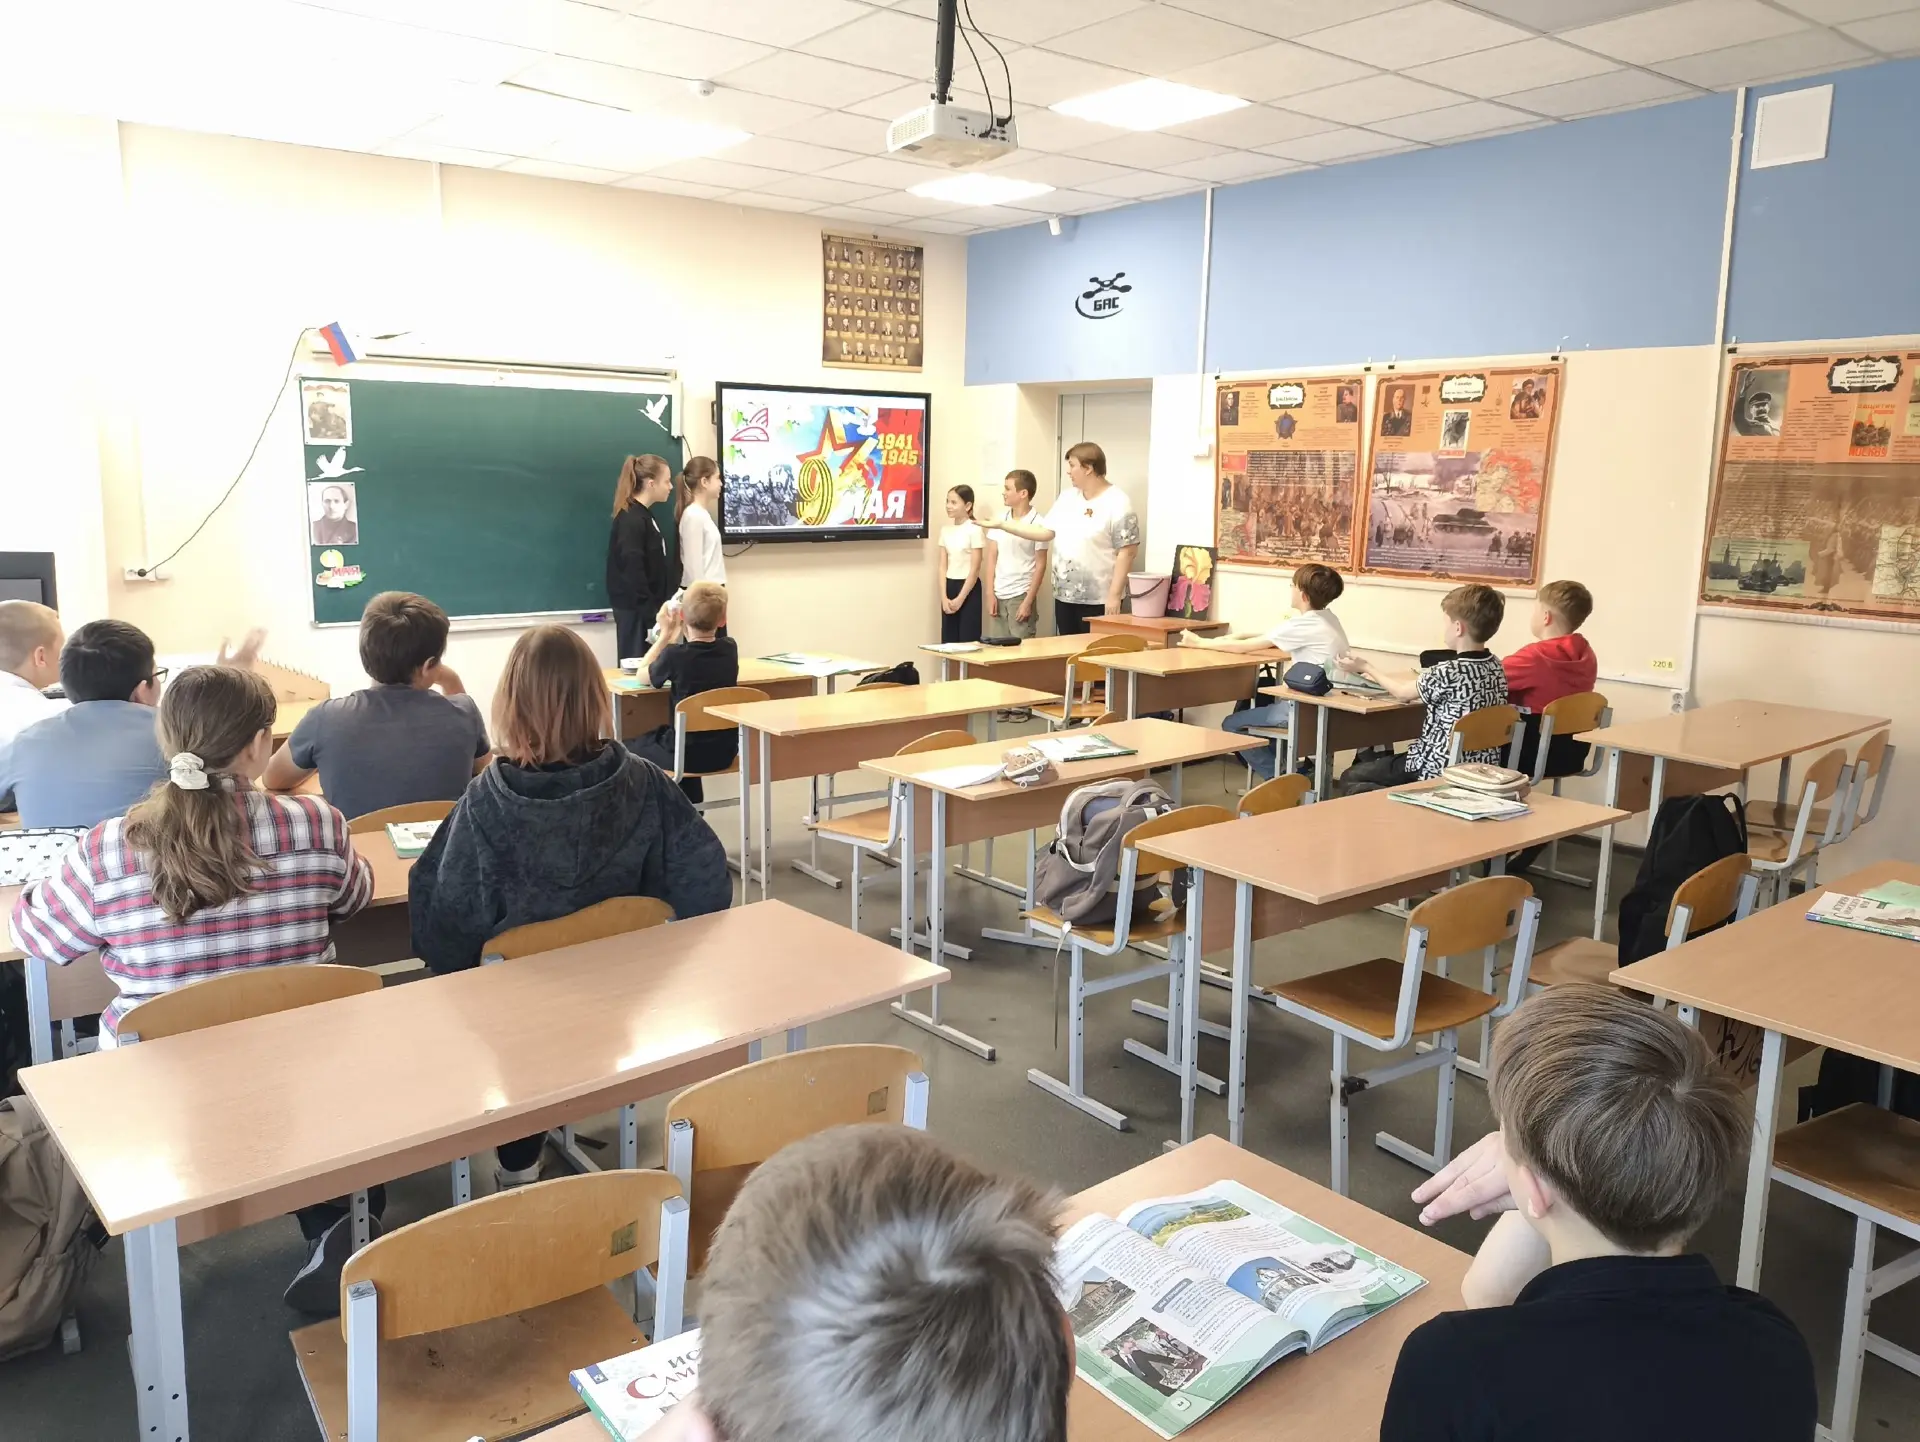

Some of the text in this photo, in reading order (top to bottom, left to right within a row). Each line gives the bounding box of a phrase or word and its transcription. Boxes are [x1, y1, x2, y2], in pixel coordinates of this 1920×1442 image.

[1093, 297, 1119, 311] GAC
[877, 433, 913, 450] 1941
[881, 449, 919, 466] 1945
[796, 459, 833, 526] 9
